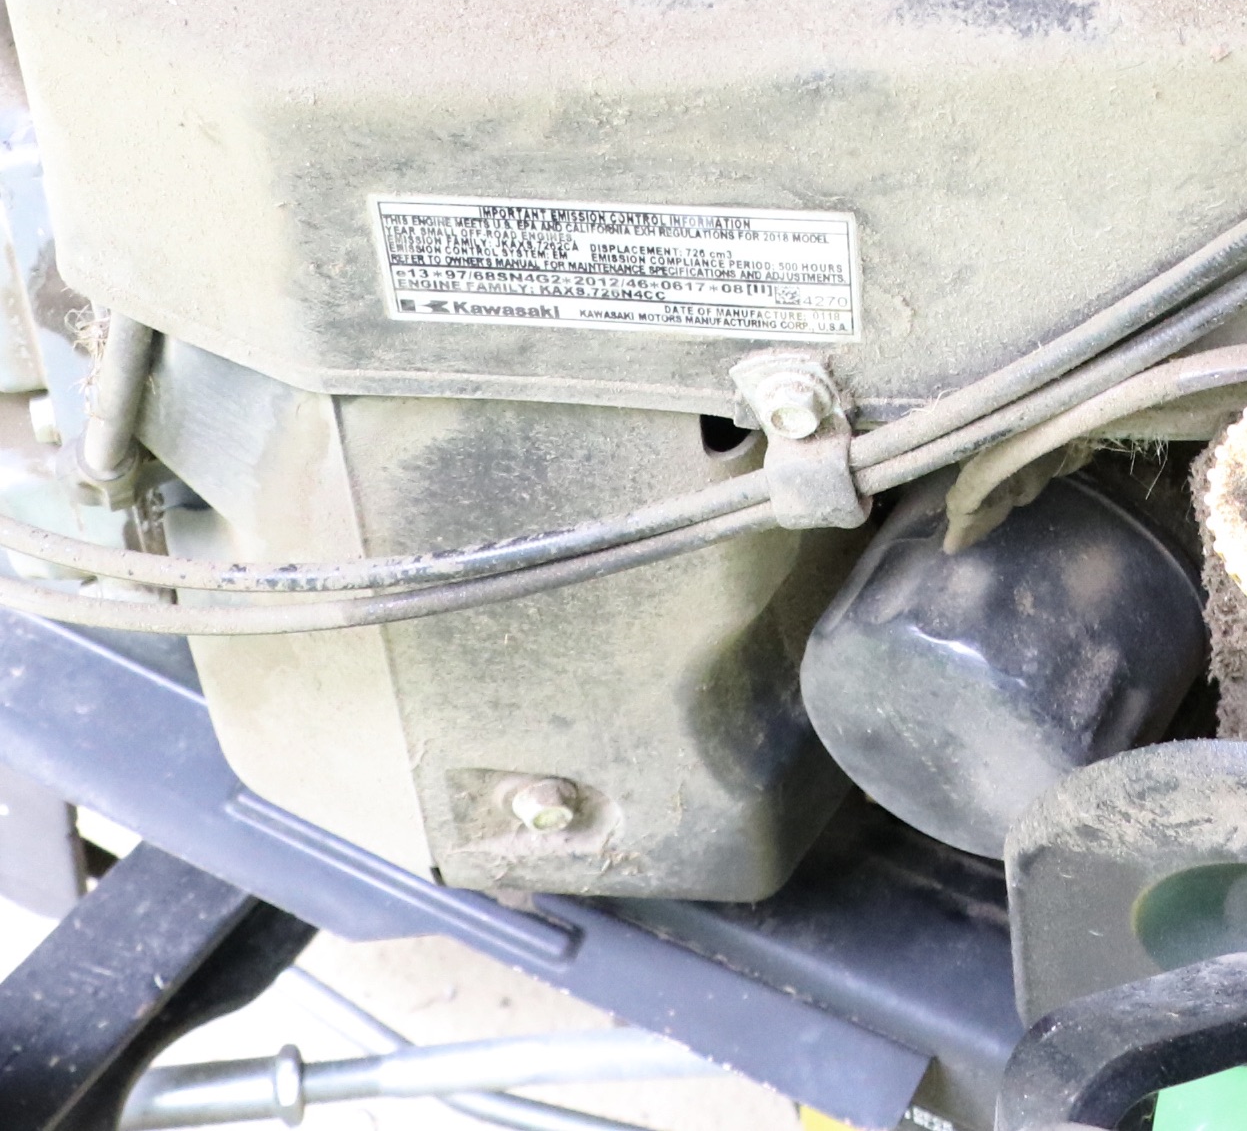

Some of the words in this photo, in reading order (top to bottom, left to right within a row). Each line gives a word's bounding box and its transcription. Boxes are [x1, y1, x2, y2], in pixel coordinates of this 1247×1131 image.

[479, 207, 546, 220] IMPORTANT
[550, 210, 605, 222] EMISSION
[609, 213, 666, 225] CONTROL
[669, 215, 750, 228] INFORMATION
[382, 214, 407, 224] THIS
[411, 216, 451, 226] ENGINE
[454, 218, 489, 228] MEETS
[516, 221, 536, 230] EPA
[540, 222, 561, 231] AND
[565, 223, 629, 234] CALIFORNIA
[634, 226, 655, 235] EXH
[658, 227, 734, 239] REGULATIONS
[738, 231, 759, 240] FOR
[763, 232, 788, 241] 2018
[792, 233, 828, 243] MODEL
[385, 225, 415, 235] YEAR
[420, 227, 456, 236] SMALL
[460, 229, 516, 239] OFF-ROAD
[387, 234, 441, 245] EMISSION
[446, 237, 491, 247] FAMILY:
[389, 243, 441, 253] EMISSION
[444, 246, 498, 256] CONTROL
[501, 249, 549, 259] SYSTEM:
[552, 251, 567, 260] EM
[590, 244, 682, 256] DISPLACEMENT:
[686, 248, 704, 257] 726
[709, 249, 732, 258] cm3
[391, 254, 424, 264] REFER
[428, 255, 441, 264] TO
[495, 259, 539, 269] MANUAL
[544, 261, 565, 270] FOR
[568, 262, 644, 274] MAINTENANCE
[648, 266, 735, 278] SPECIFICATIONS
[740, 270, 761, 279] AND
[765, 271, 846, 283] ADJUSTMENTS.
[591, 253, 645, 263] EMISSION
[650, 256, 724, 267] COMPLIANCE
[728, 260, 774, 269] PERIOD:
[778, 262, 797, 271] 500
[801, 263, 842, 273] HOURS
[397, 279, 461, 290] ENGINE
[466, 282, 534, 294] FAMILY:
[453, 301, 560, 318] Kawasaki
[803, 295, 847, 307] 4270
[579, 310, 634, 320] KAWASAKI
[638, 313, 681, 323] MOTORS
[685, 316, 776, 328] MANUFACTURING
[664, 305, 694, 314] DATE
[697, 306, 711, 315] OF
[715, 307, 805, 320] MANUFACTURE:
[812, 311, 840, 321] 0118
